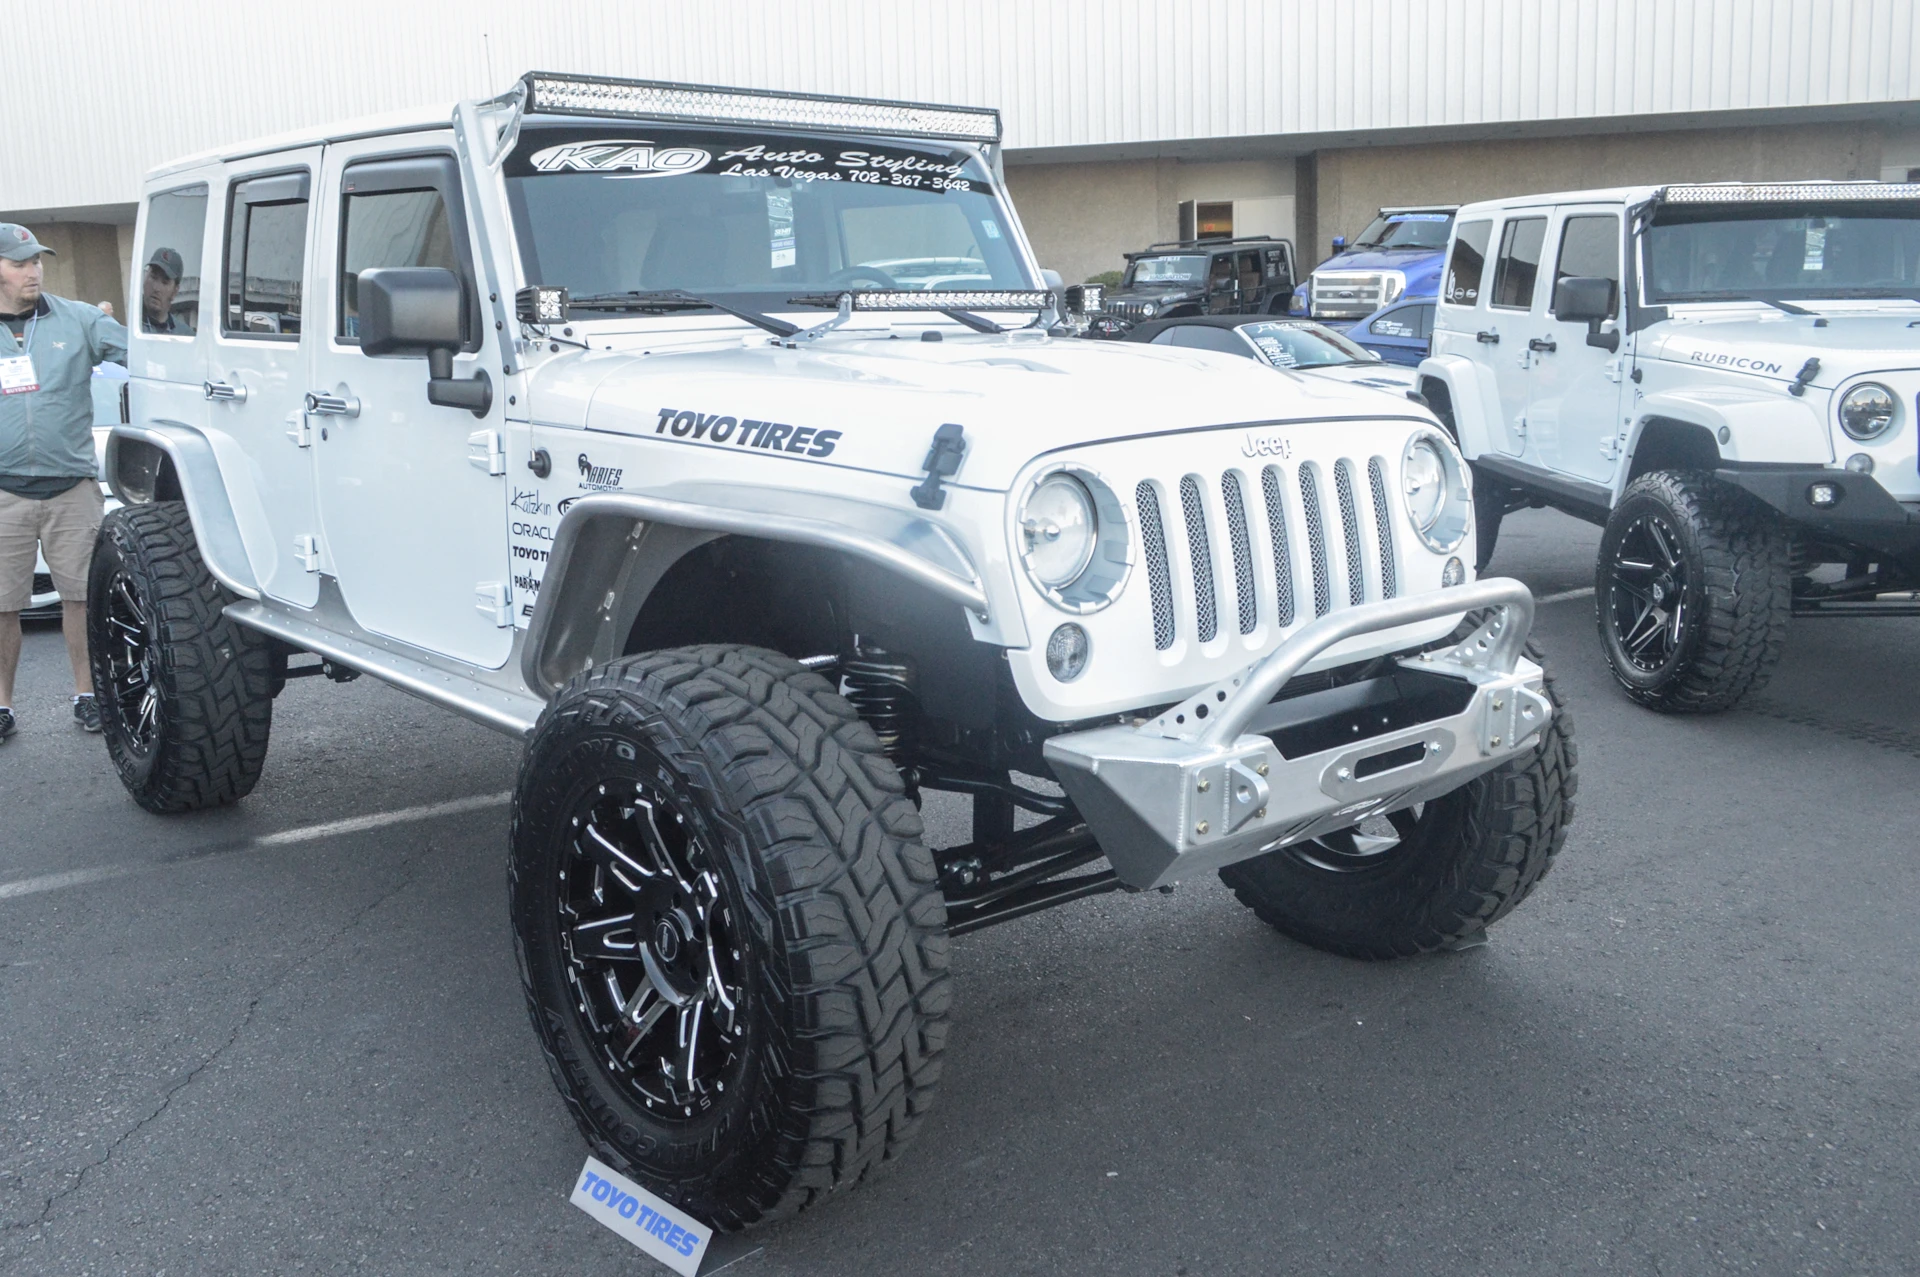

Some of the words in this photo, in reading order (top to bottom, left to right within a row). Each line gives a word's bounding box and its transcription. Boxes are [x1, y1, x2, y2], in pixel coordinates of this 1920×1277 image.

[537, 145, 711, 172] KAO
[718, 144, 825, 164] Auto
[835, 151, 965, 181] Styling
[719, 163, 770, 177] Las
[774, 165, 843, 182] Vegas
[849, 170, 970, 191] 702-367-3642
[1690, 351, 1782, 374] RUBICON
[655, 408, 738, 443] TOYO
[736, 419, 844, 458] TIRES
[1241, 433, 1292, 459] Jeep
[587, 466, 623, 486] ARIES
[511, 486, 551, 516] Katzkin
[512, 522, 554, 541] ORACL
[512, 545, 539, 561] TOYO
[581, 1170, 639, 1219] TOYO
[636, 1204, 700, 1257] TIRES
